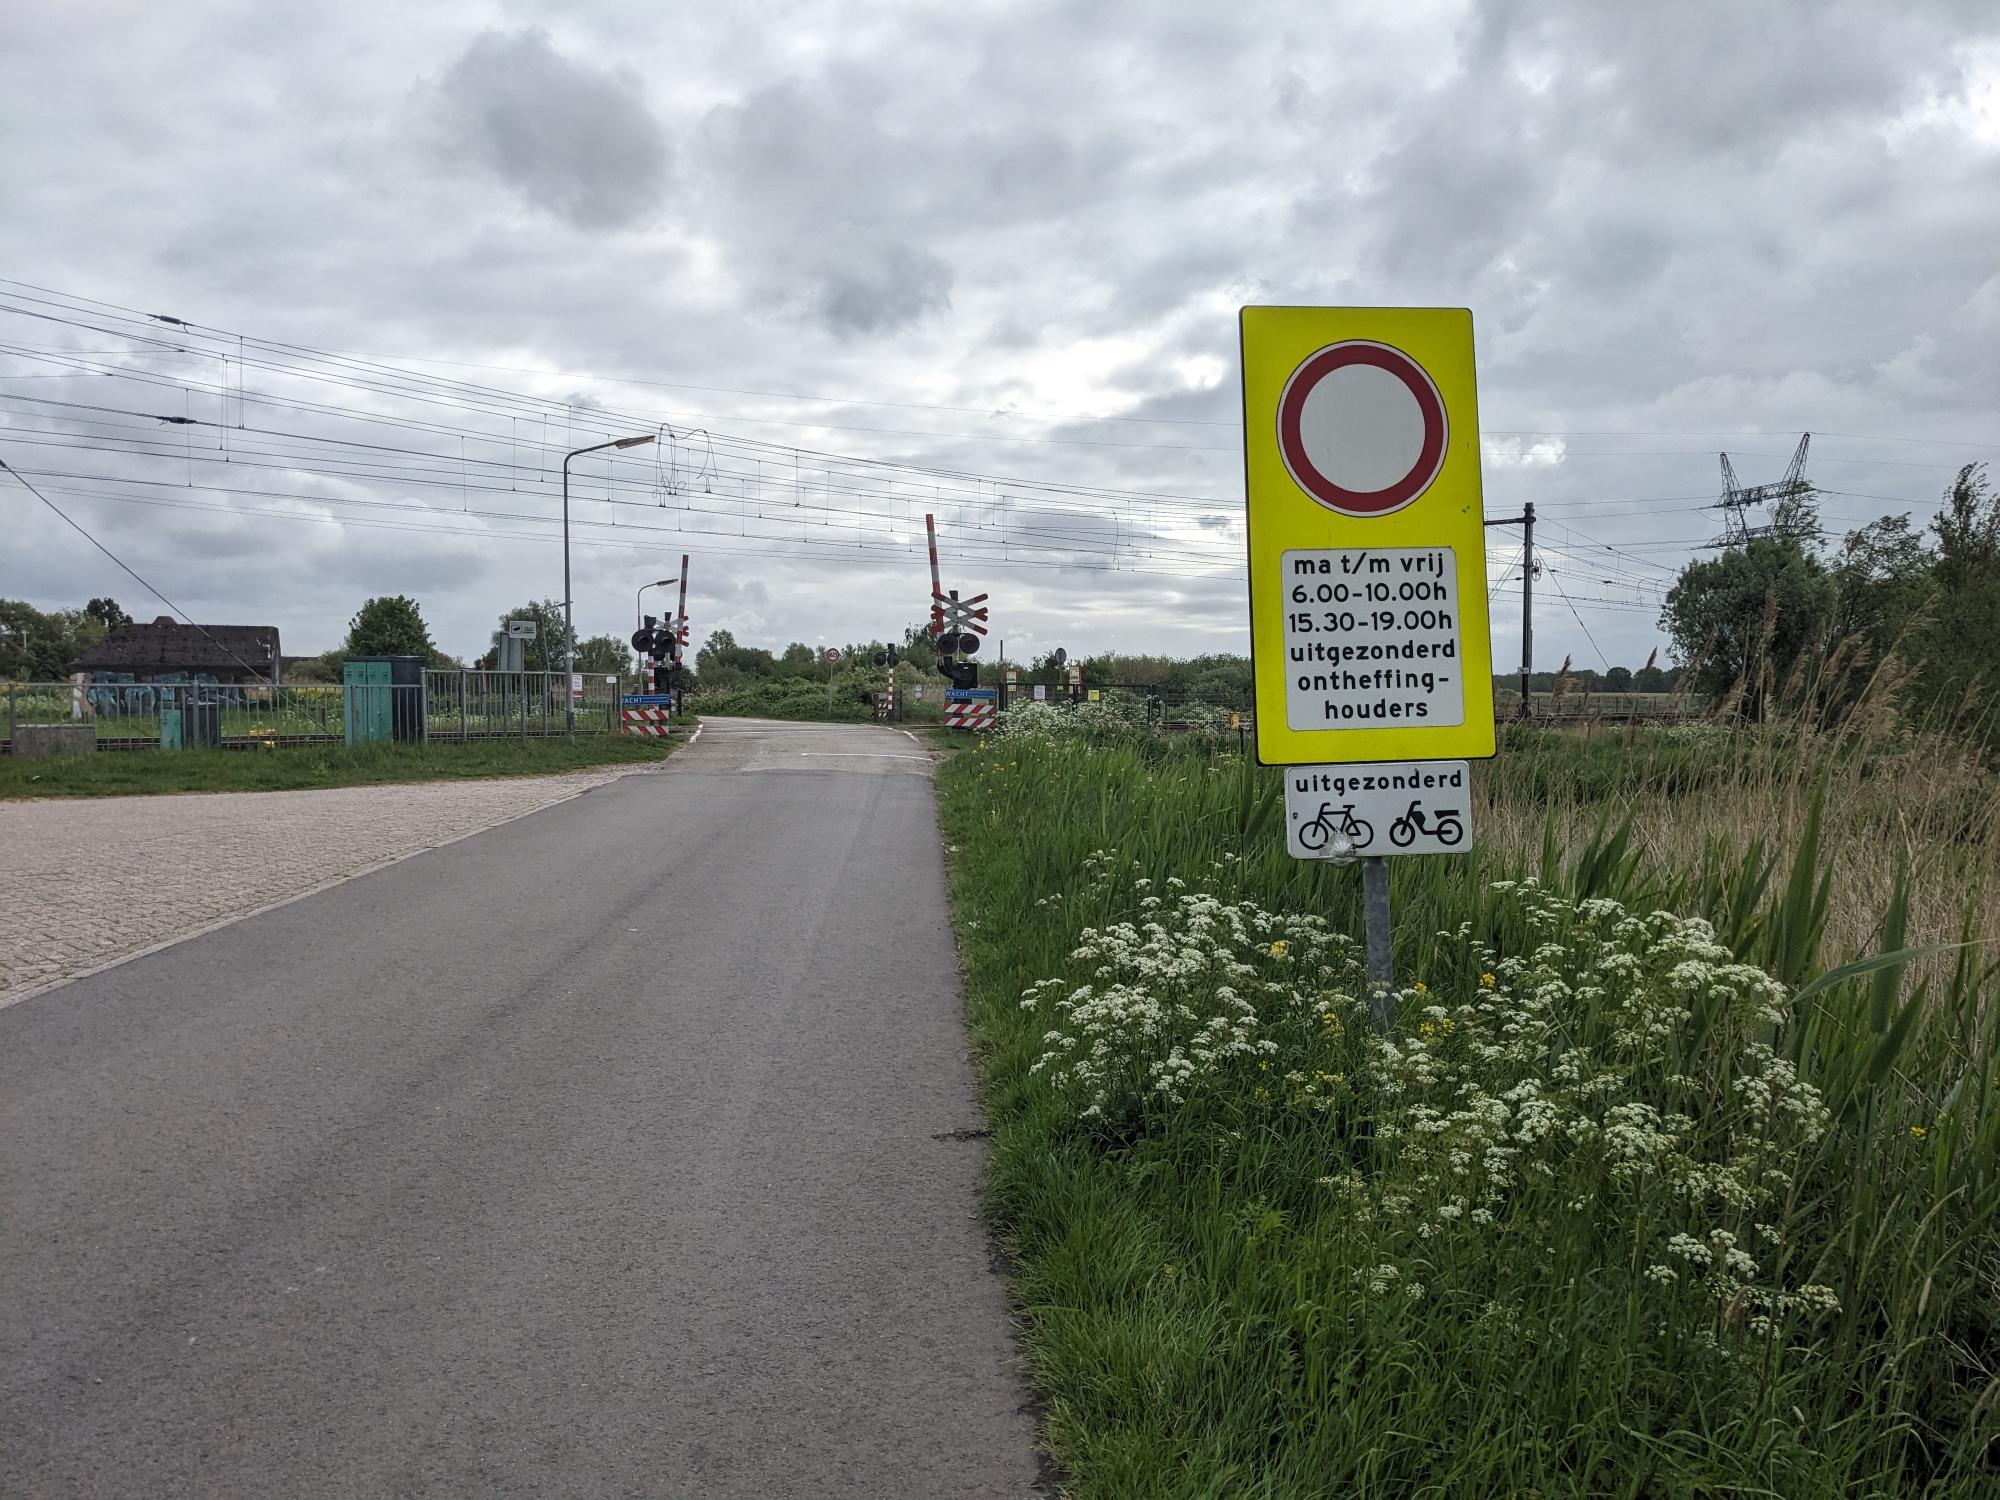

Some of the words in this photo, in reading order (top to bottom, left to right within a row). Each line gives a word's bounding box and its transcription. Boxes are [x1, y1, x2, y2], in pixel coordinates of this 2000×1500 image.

[1294, 559, 1332, 575] ma
[1340, 551, 1391, 576] t/m
[1400, 552, 1444, 579] vrij
[1291, 581, 1447, 604] 6.00-10.00h
[1288, 609, 1453, 633] 15.30-19.00h
[1290, 637, 1456, 668] uitgezonderd
[1297, 669, 1449, 695] ontheffing-
[1324, 697, 1428, 720] houders
[1295, 767, 1462, 798] uitgezonderd
